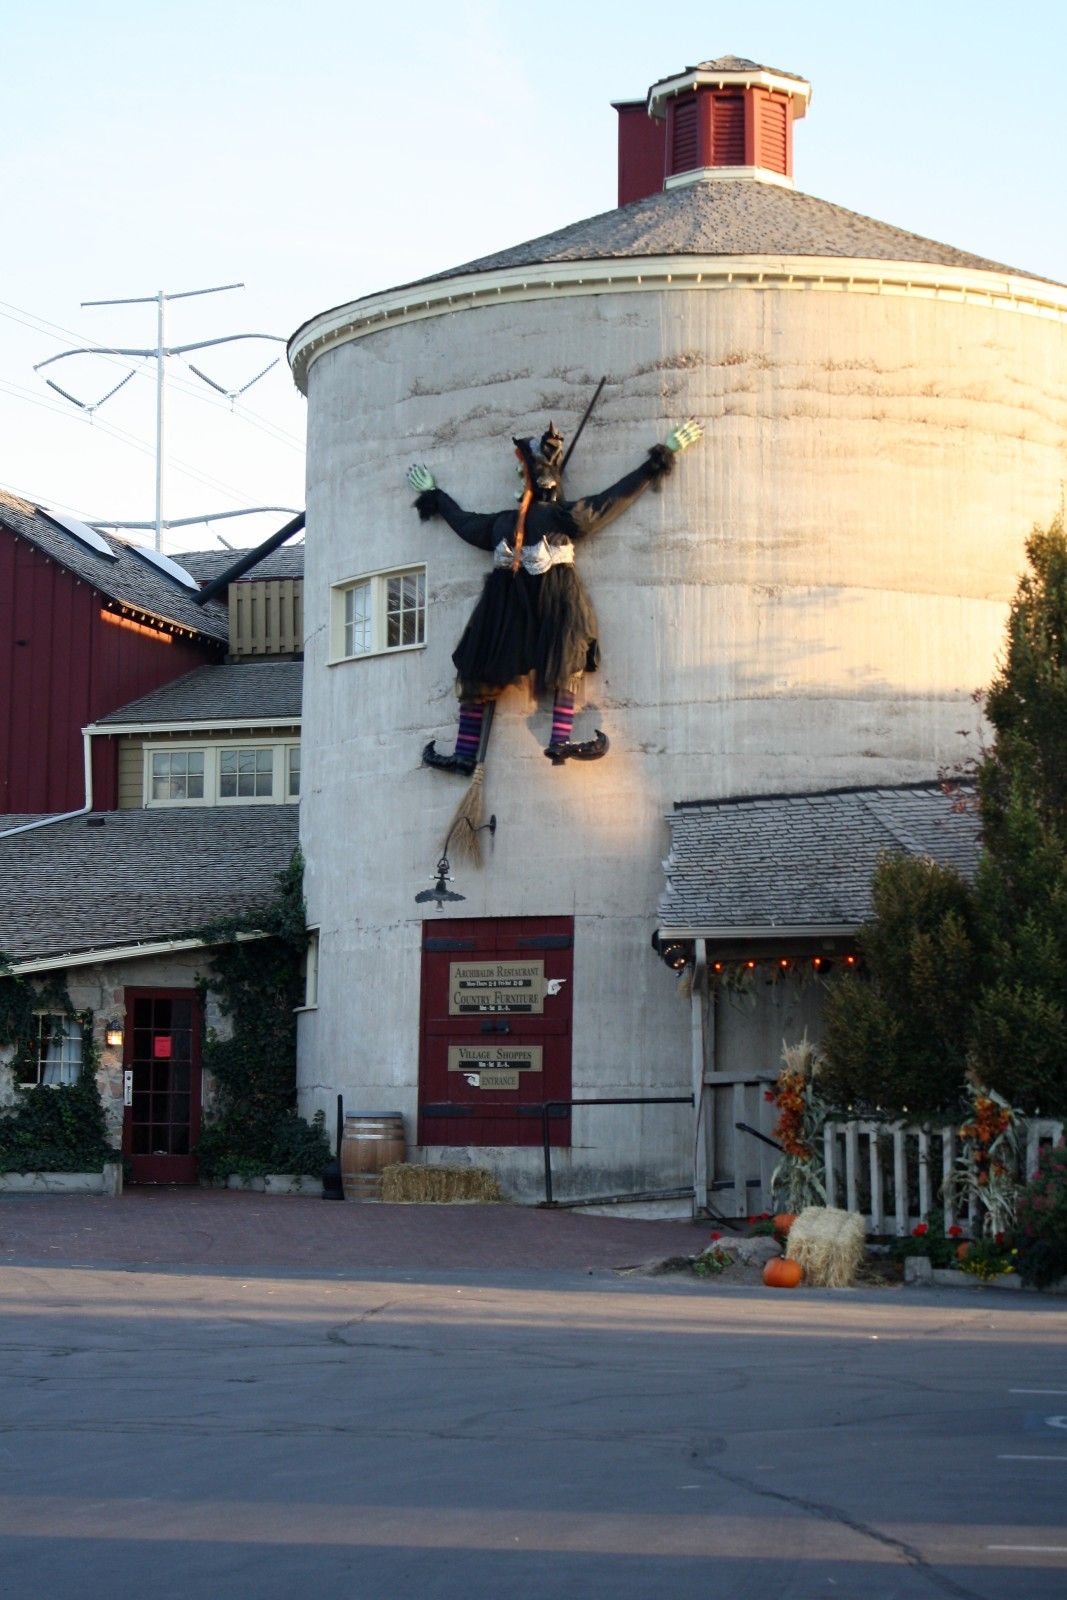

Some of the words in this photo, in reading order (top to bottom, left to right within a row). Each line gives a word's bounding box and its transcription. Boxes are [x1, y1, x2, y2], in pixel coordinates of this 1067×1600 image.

[496, 965, 539, 977] RESTAURANT
[454, 992, 490, 1004] COUNTRY
[495, 991, 539, 1004] FURNITURE
[459, 1048, 490, 1059] VILLAGE
[496, 1048, 532, 1059] SHOPPES
[482, 1076, 516, 1086] ENTRANCE
